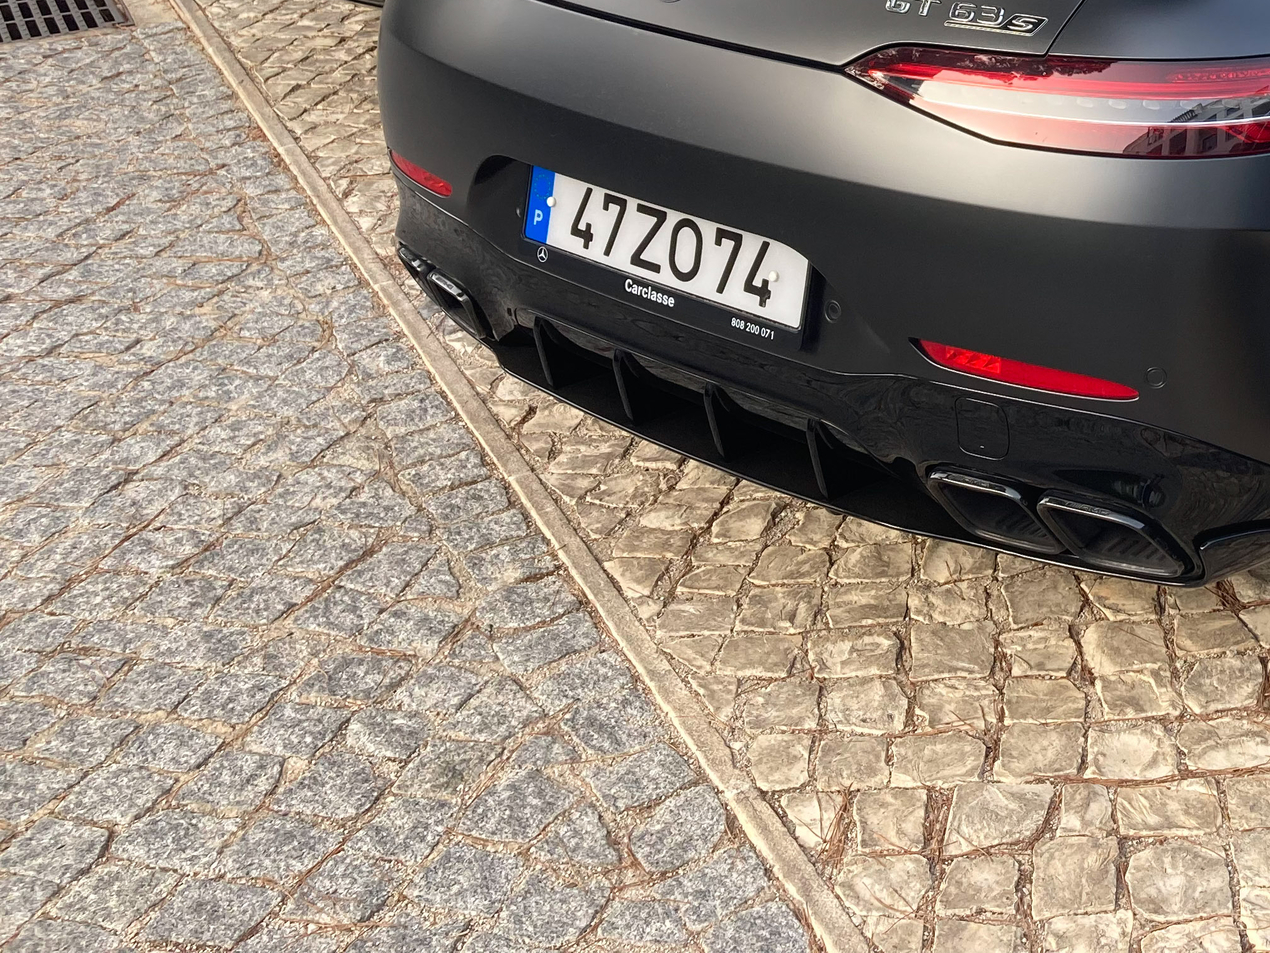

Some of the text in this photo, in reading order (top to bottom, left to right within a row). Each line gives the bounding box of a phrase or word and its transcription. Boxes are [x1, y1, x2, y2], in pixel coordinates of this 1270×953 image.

[533, 209, 543, 225] P
[624, 278, 675, 308] Carclasse
[731, 317, 775, 340] 808 200 071
